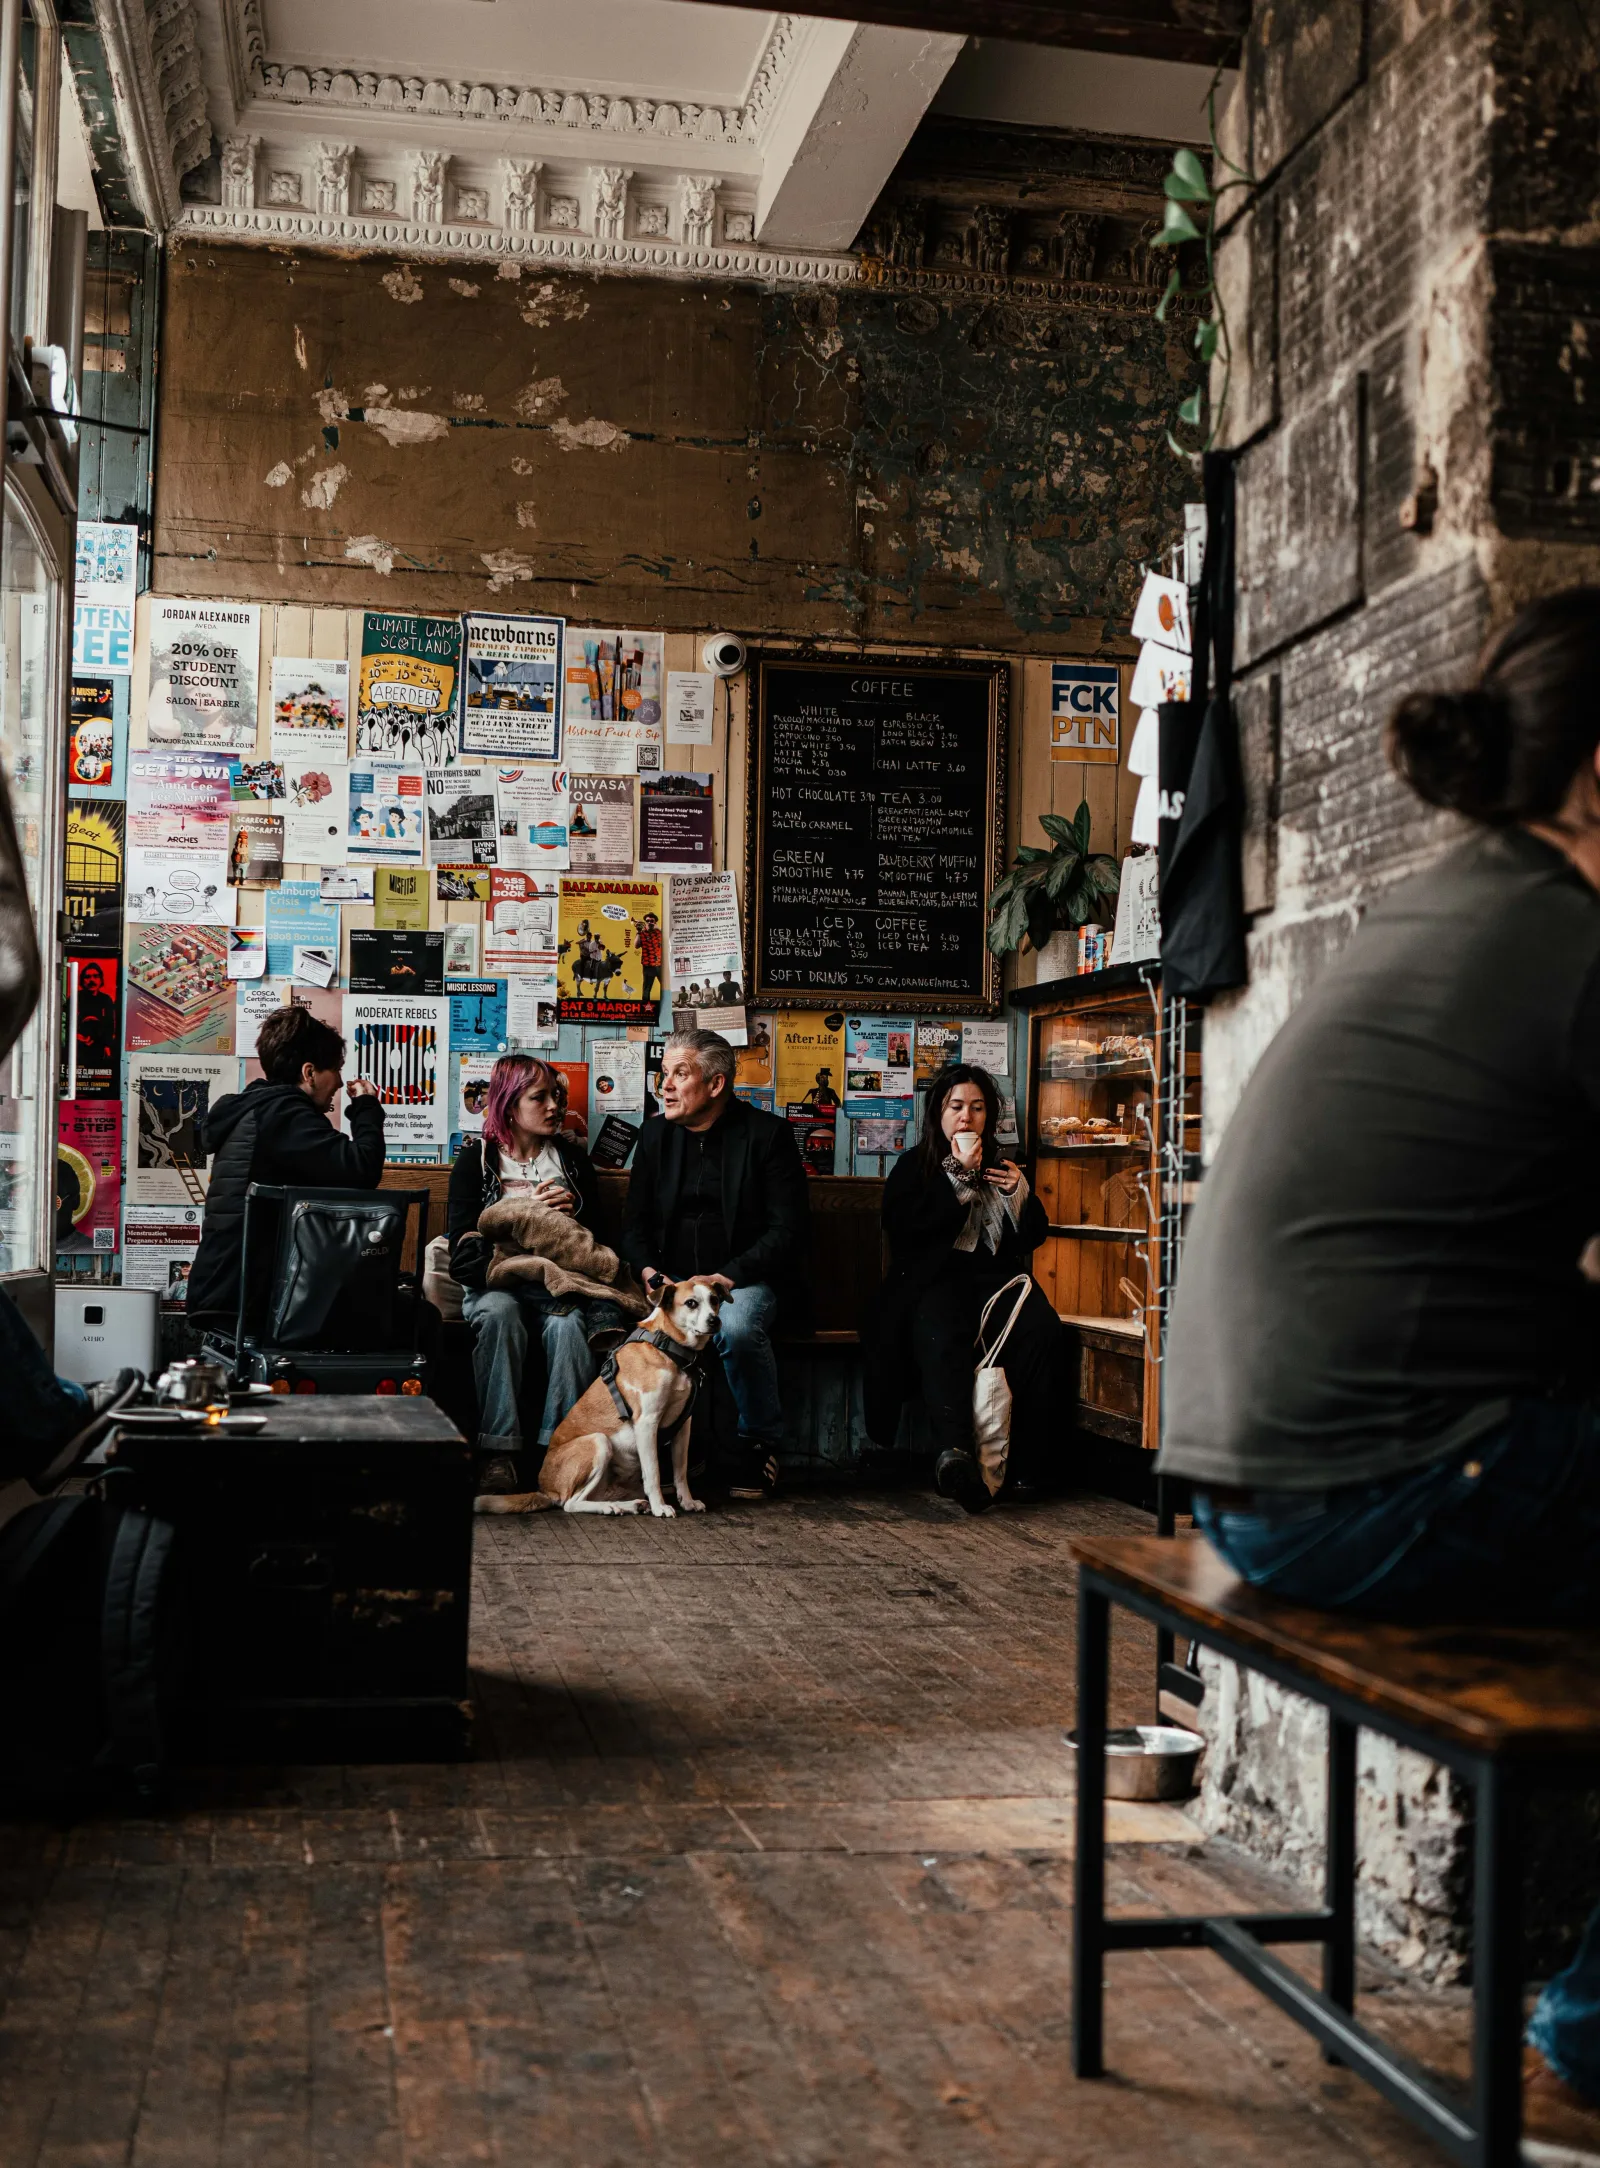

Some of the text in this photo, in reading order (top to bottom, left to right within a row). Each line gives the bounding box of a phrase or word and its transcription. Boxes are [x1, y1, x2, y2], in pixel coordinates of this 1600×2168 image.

[162, 609, 250, 624] JORDAN ALEXANDER
[368, 617, 462, 640] CLIMATE CAMP
[470, 624, 556, 647] newbarns
[380, 635, 452, 655] SCOTLAND
[469, 642, 555, 654] BREWERY TAPROOM
[171, 643, 238, 659] 20% OFF
[486, 651, 547, 661] BEER GARDEN
[172, 661, 236, 674] STUDENT
[374, 659, 436, 674] Save the date!
[169, 675, 238, 688] DISCOUNT
[421, 674, 441, 688] July
[76, 687, 97, 696] MUSIC
[851, 680, 914, 697] COFFEE
[373, 685, 440, 706] ABERDEEN
[1052, 684, 1117, 713] FCK
[166, 697, 240, 708] SALON BARBER
[800, 705, 838, 717] WHITE
[906, 712, 940, 722] BLACK
[492, 720, 548, 730] JANE STREET
[773, 724, 812, 732] CORTADO
[882, 720, 922, 729] ESPRESSO
[1052, 716, 1116, 744] PTN
[566, 725, 601, 738] Abstract
[773, 732, 820, 740] CAPPUCCINO
[882, 729, 935, 739] LONG BLACK
[773, 740, 831, 750] FLAT WHITE
[880, 738, 934, 747] BATCH BREW
[774, 748, 803, 758] LATTE
[370, 761, 406, 769] Language
[773, 756, 802, 765] MOCHA
[876, 759, 900, 770] CHAI
[906, 761, 941, 771] LATTE
[131, 763, 168, 776] GET
[426, 770, 442, 778] LEITH
[443, 769, 462, 777] FIGHTS
[795, 767, 820, 776] MILK
[156, 780, 213, 791] Anna Cee
[427, 779, 444, 795] NO
[175, 792, 218, 803] Marvin
[771, 786, 857, 802] HOT CHOCOLATE
[880, 792, 912, 804] TEA
[772, 810, 802, 821] PLAIN
[948, 808, 971, 818] GREY
[236, 816, 280, 826] SCARECROW
[772, 820, 853, 831] SALTED CARAMEL
[68, 822, 101, 842] Beat
[233, 825, 283, 835] WOODCRAFTS
[167, 836, 199, 844] ARCHES
[876, 833, 921, 843] CHAI TEA
[772, 849, 825, 864] GREEN
[878, 853, 977, 868] BLUEBERRY MUFFIN
[771, 865, 834, 879] SMOOTHIE
[878, 870, 935, 883] SMOOTHIE
[673, 875, 731, 887] LOVE SINGING?
[562, 881, 659, 895] BALKANARAMA
[813, 887, 851, 897] BANANA
[910, 890, 978, 900] PEANUT LEMON
[270, 896, 299, 906] Crisis
[815, 916, 928, 932] ICED COFFEE
[769, 928, 830, 939] ICED LATTE
[877, 931, 930, 942] ICED CHAI
[768, 946, 791, 956] COLD
[794, 947, 822, 957] BREW
[877, 941, 930, 952] ICED TEA
[769, 969, 848, 985] SOFT DRINKS
[446, 982, 496, 992] MUSIC LESSONS
[561, 1002, 641, 1012] SAT 9 MARCH
[355, 1007, 437, 1019] MODERATE REBELS
[784, 1032, 839, 1045] After Life
[73, 1123, 116, 1133] STEP
